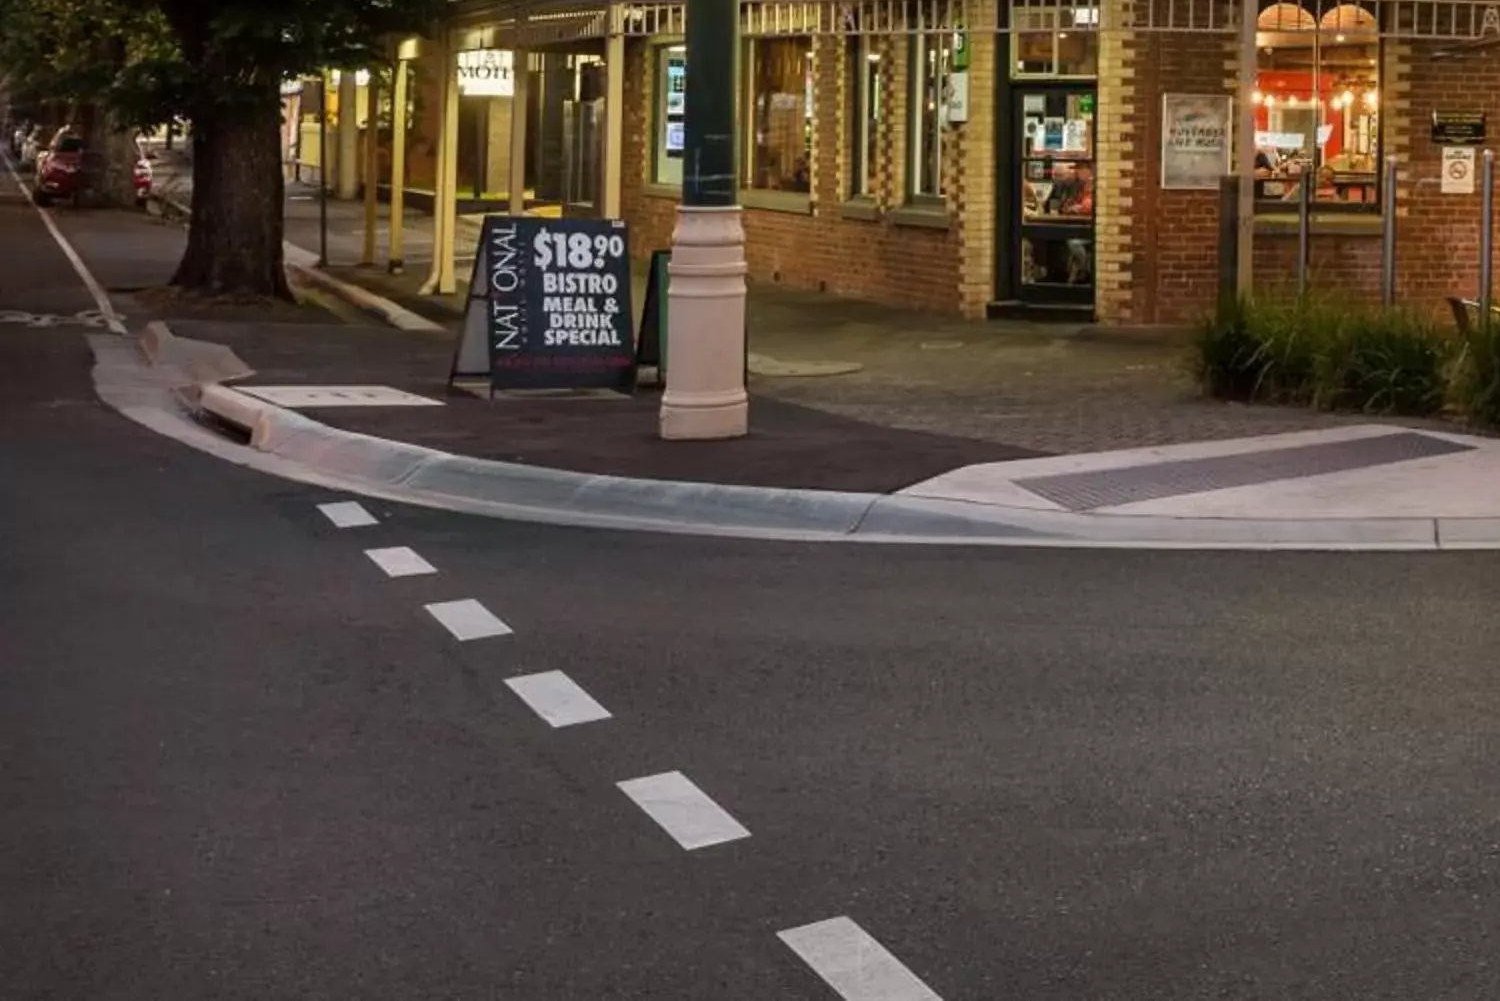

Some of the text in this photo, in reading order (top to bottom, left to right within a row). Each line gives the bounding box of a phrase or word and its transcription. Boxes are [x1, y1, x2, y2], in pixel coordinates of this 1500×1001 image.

[492, 223, 520, 349] NATONAL
[543, 272, 618, 294] BISTRO
[543, 296, 620, 314] MEAL &
[550, 313, 613, 330] DRINK
[543, 329, 622, 346] SPECIAL
